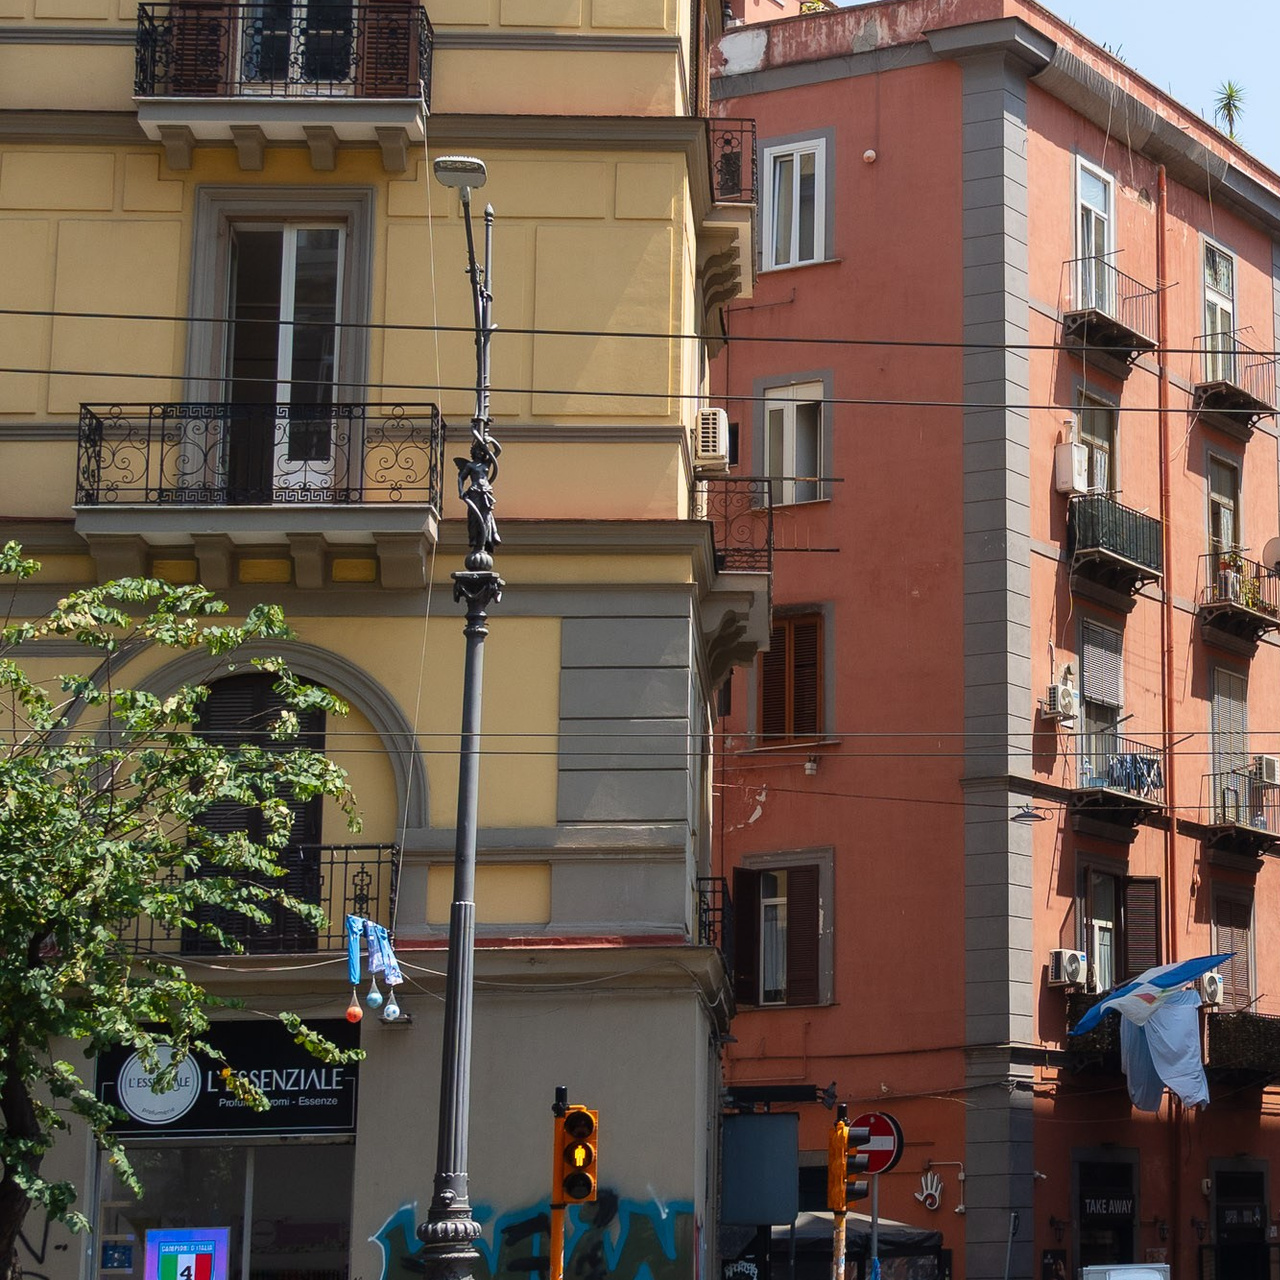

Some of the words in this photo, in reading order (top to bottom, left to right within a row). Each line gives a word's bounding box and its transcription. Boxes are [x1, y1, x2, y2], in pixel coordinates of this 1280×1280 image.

[298, 1096, 338, 1106] Essenze
[1085, 1199, 1107, 1214] TAKE
[1108, 1199, 1133, 1214] AWAY
